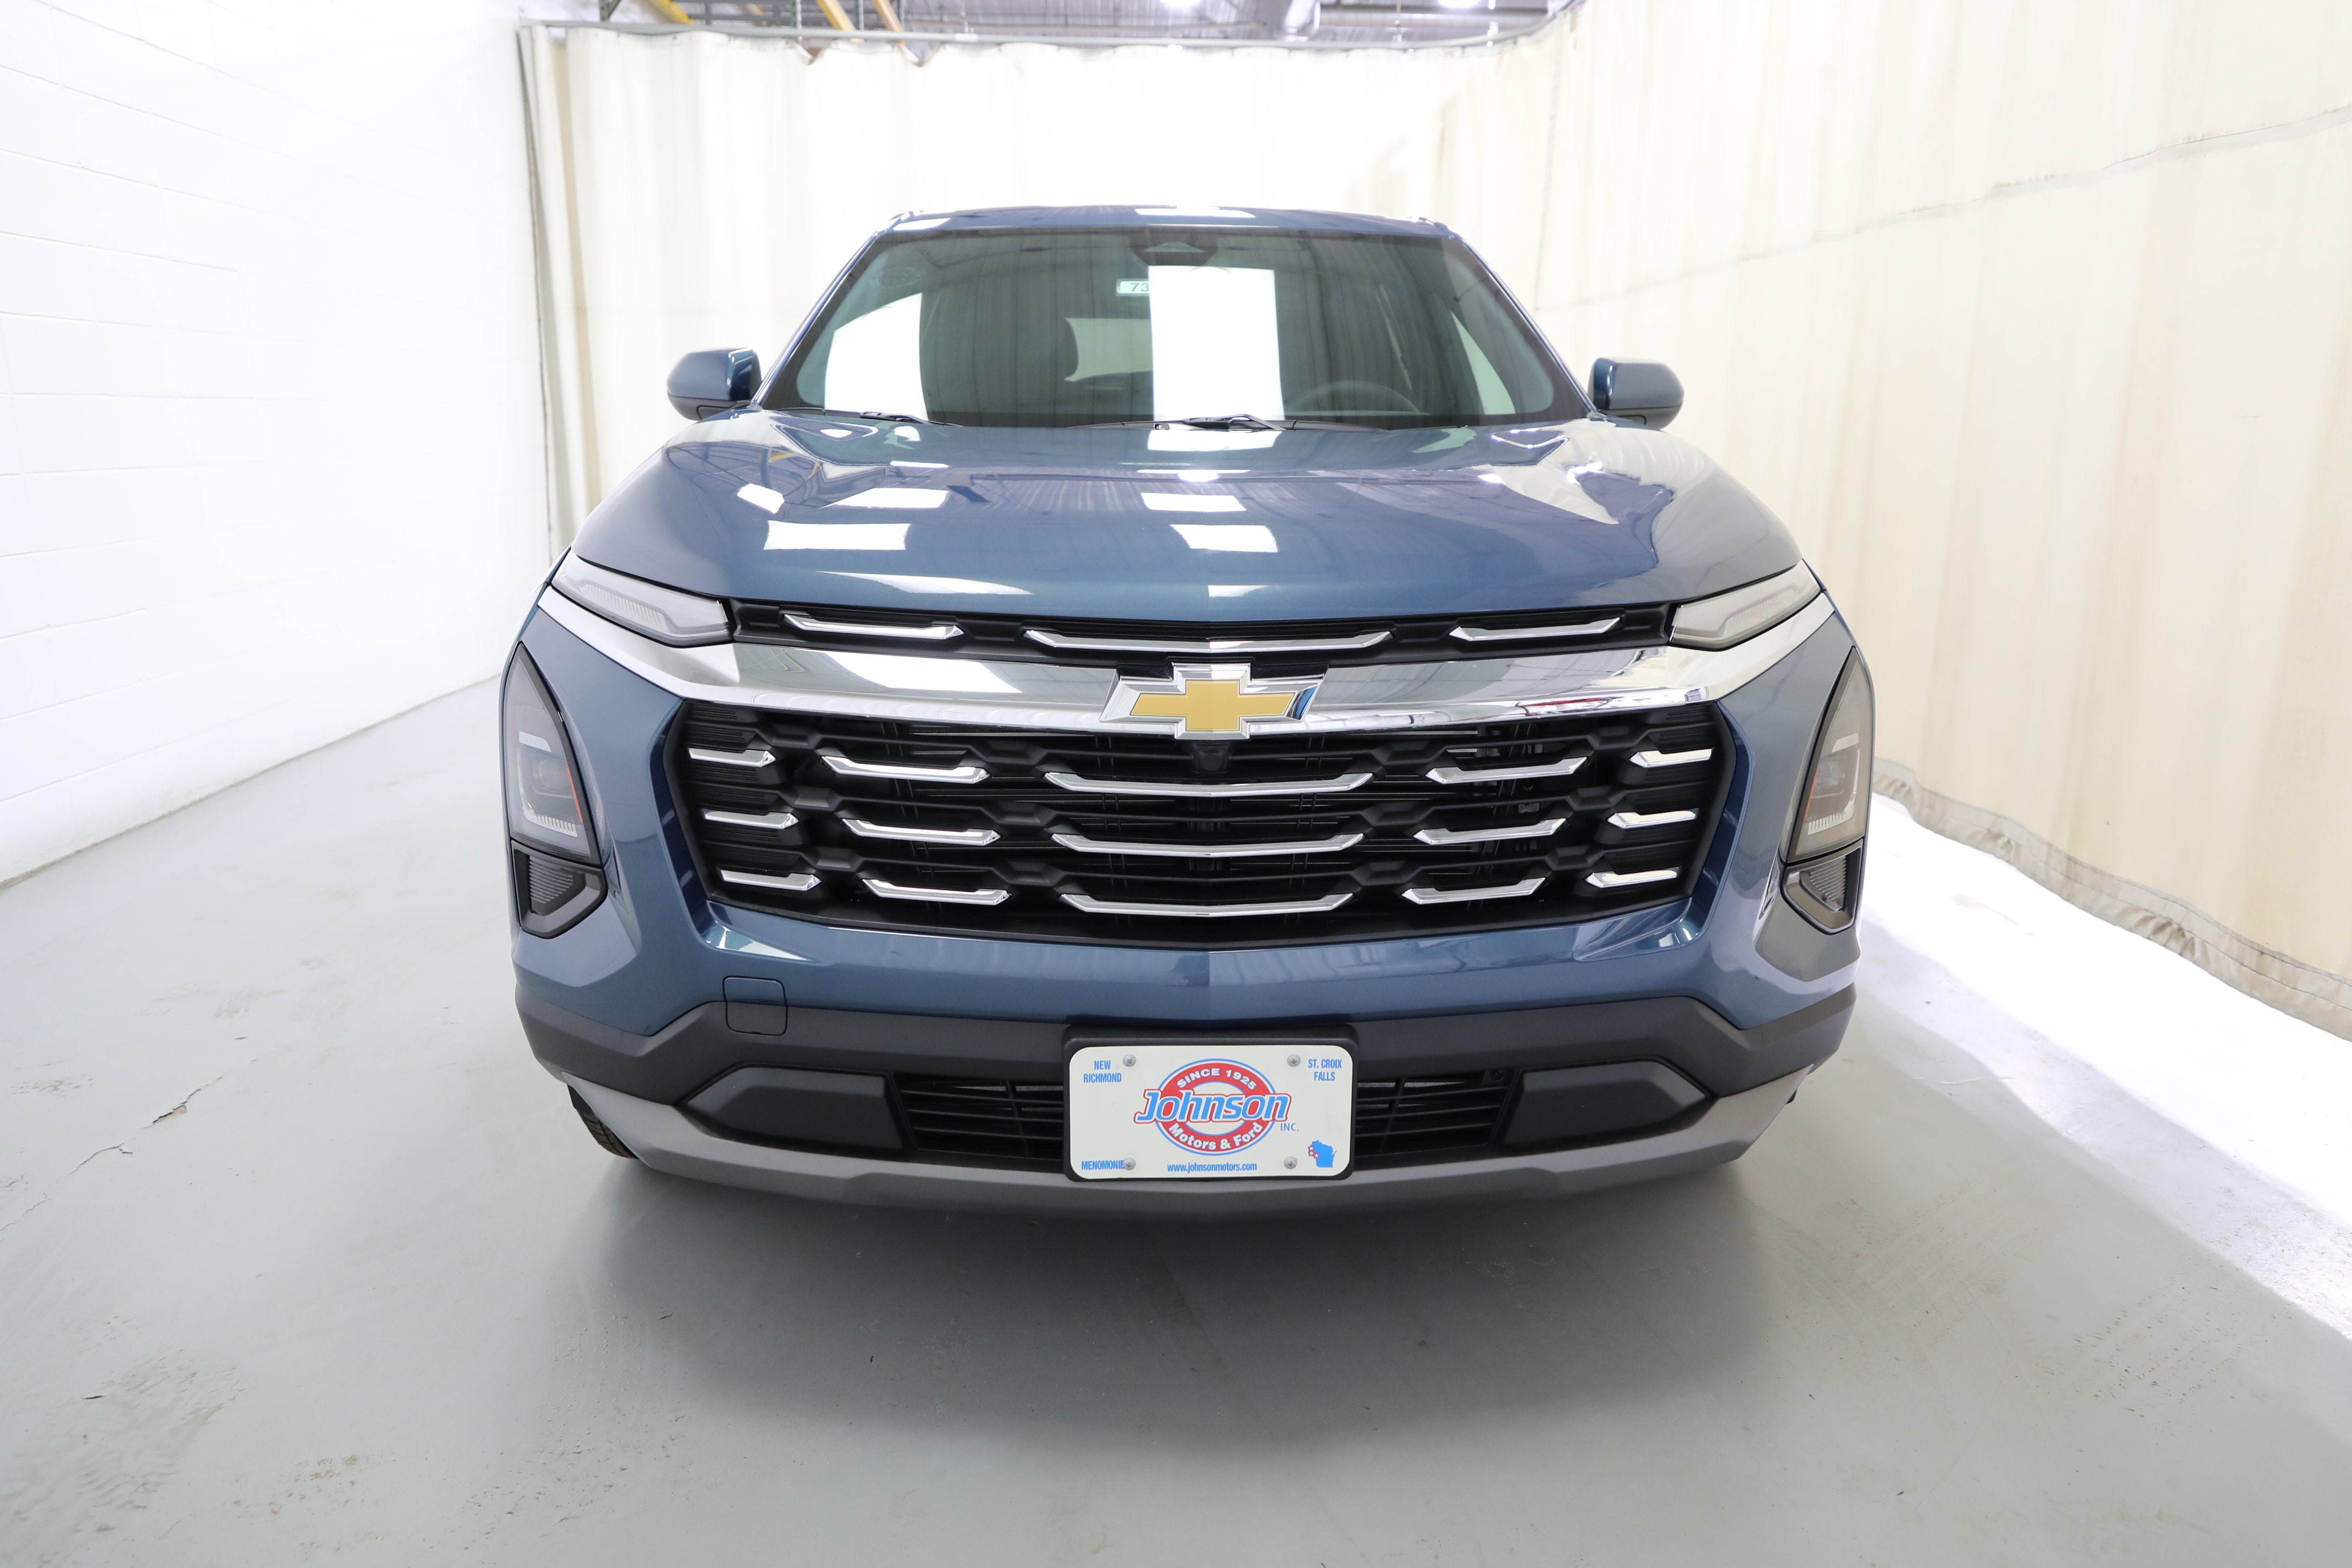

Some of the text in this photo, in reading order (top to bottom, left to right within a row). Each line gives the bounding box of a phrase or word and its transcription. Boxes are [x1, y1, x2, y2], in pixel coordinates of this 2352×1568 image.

[1094, 1060, 1111, 1070] NEW
[1308, 1059, 1342, 1069] ST. CROIX
[1083, 1073, 1122, 1083] RICHMOND
[1177, 1068, 1257, 1090] SINCE 1925
[1314, 1071, 1336, 1081] FALLS
[1135, 1090, 1290, 1121] Johnson
[1280, 1123, 1299, 1132] INC.
[1168, 1122, 1263, 1150] Motors & Ford
[1081, 1160, 1124, 1170] MENOMONIE
[1167, 1162, 1257, 1174] www.johnsonmotors.com
